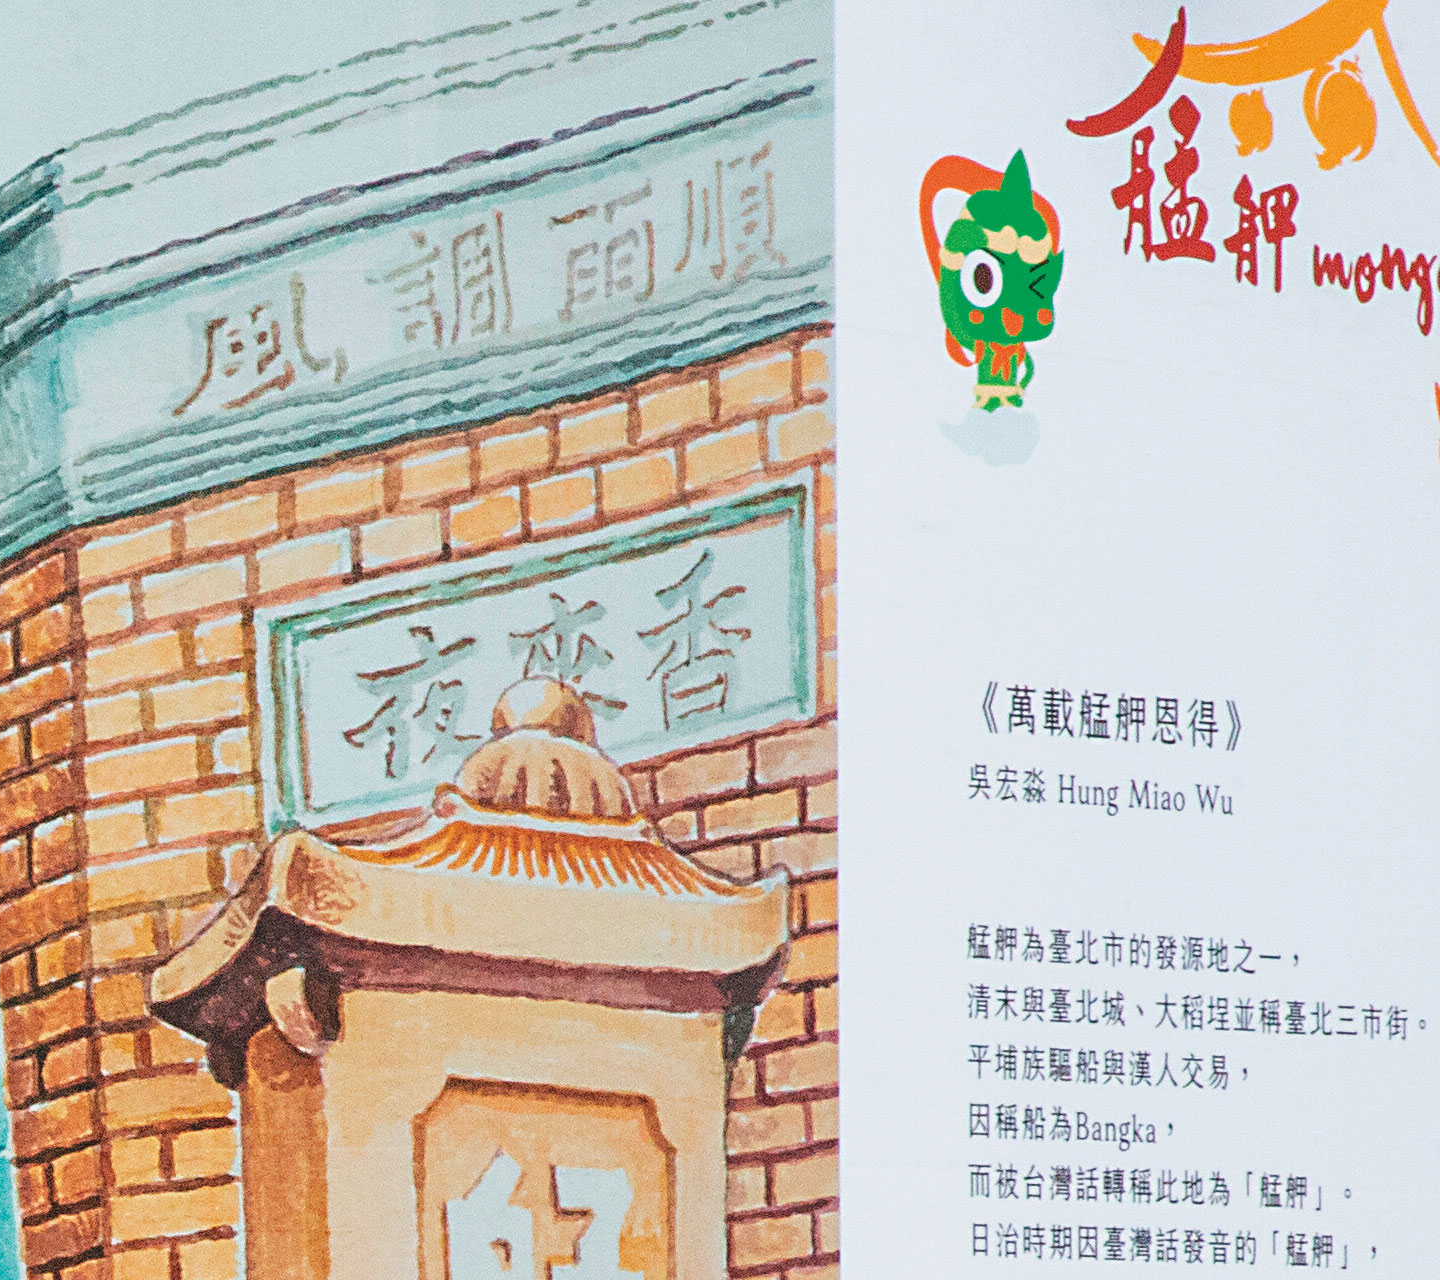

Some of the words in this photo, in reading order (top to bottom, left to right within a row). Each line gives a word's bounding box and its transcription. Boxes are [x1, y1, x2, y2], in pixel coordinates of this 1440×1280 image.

[1111, 95, 1299, 292] 艋舺
[174, 142, 787, 415] 風調雨順
[1313, 243, 1440, 336] mong
[1058, 774, 1119, 817] Hung
[1128, 779, 1185, 812] Miao
[1195, 783, 1234, 815] Wu
